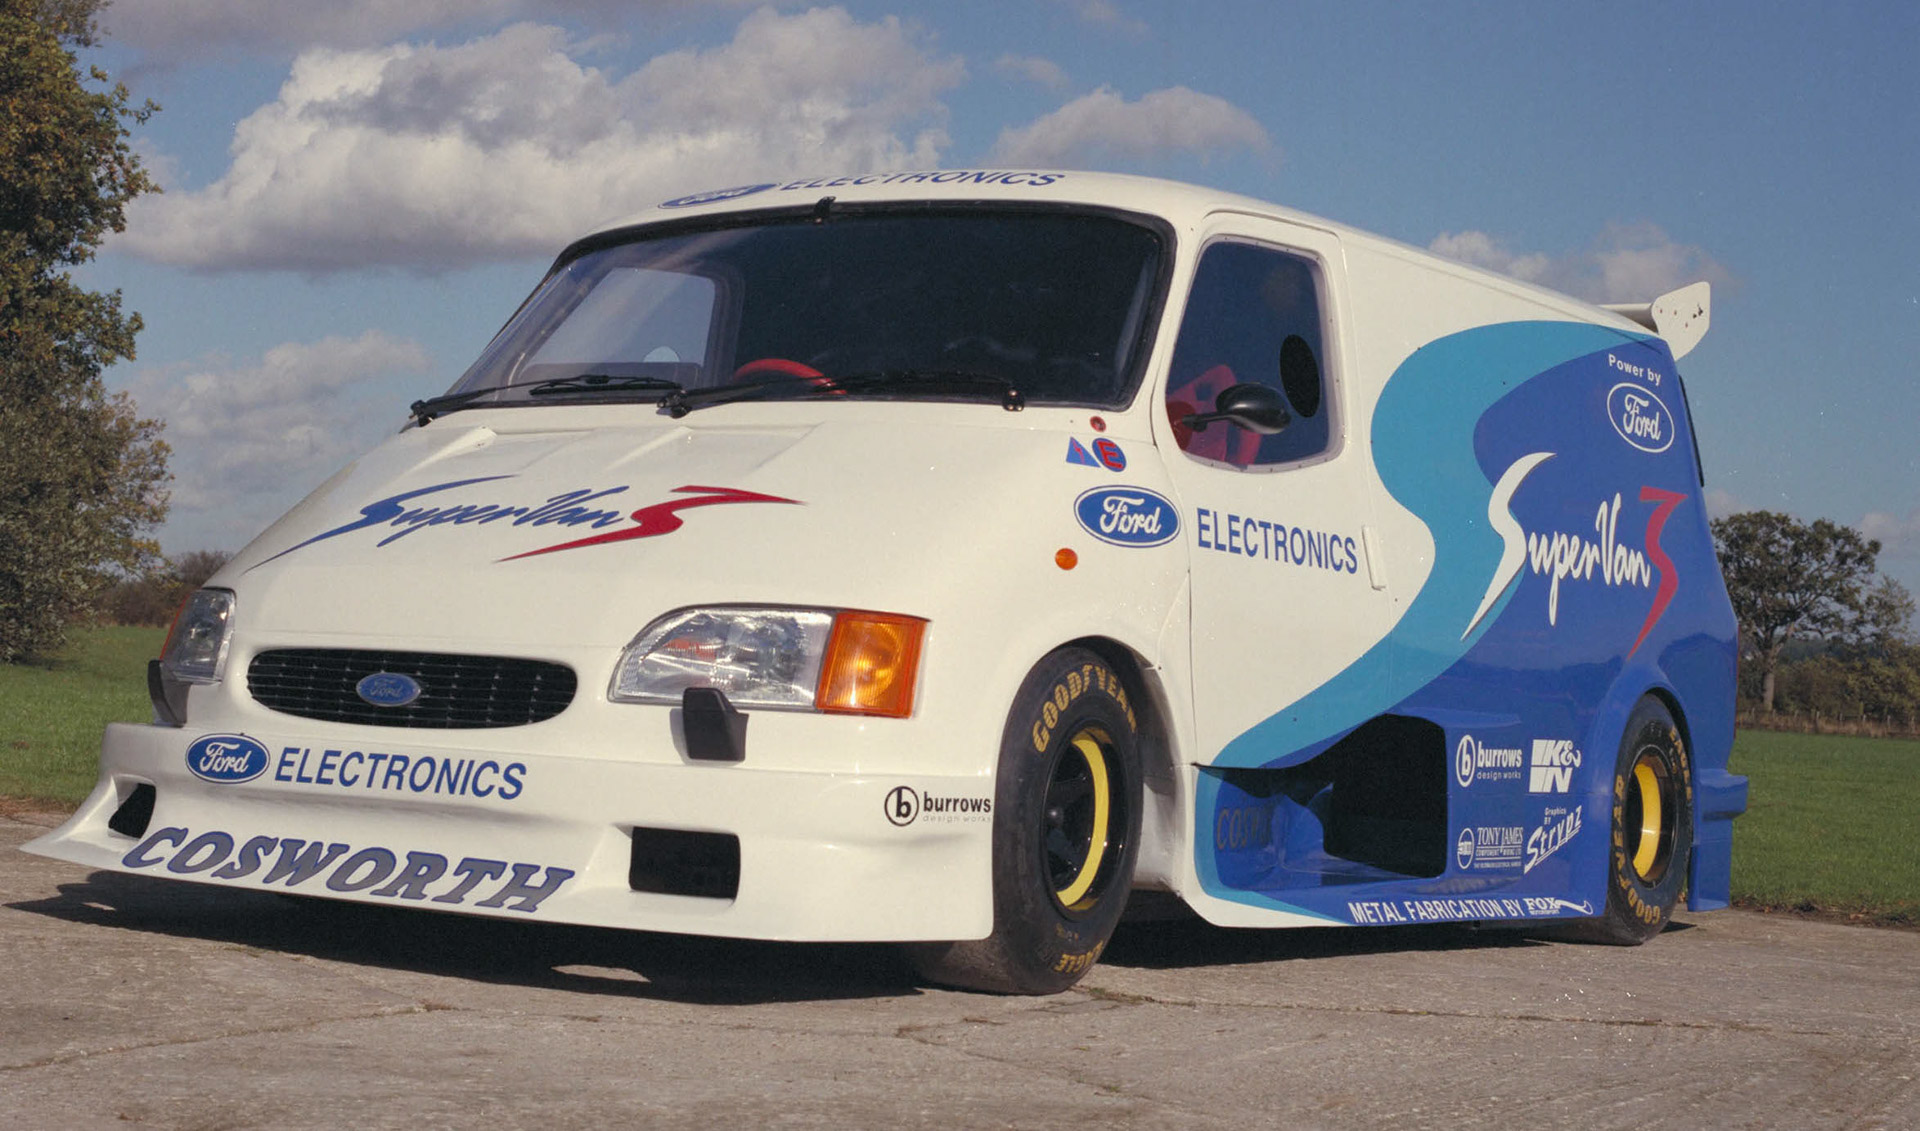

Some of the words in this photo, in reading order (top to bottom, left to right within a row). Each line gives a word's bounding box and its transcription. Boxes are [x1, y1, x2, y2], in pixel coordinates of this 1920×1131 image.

[780, 171, 1065, 191] ELECTRONICS
[1608, 353, 1644, 377] Power
[1647, 367, 1662, 386] by
[1623, 393, 1662, 441] Ford
[1097, 440, 1124, 469] E
[241, 474, 631, 576] SuperVan
[1100, 495, 1162, 535] Ford
[1196, 507, 1358, 575] ELECTRONICS
[1461, 452, 1651, 641] SuperVan
[1627, 485, 1689, 662] 3
[1032, 664, 1137, 752] GOODYEAR
[199, 741, 251, 774] Ford
[1477, 741, 1523, 768] burrows
[274, 747, 527, 800] ELECTRONICS
[1476, 771, 1502, 781] design
[1503, 771, 1522, 779] works
[923, 791, 991, 813] burrows
[923, 815, 960, 823] design
[1477, 826, 1500, 845] TONY
[1500, 826, 1523, 853] JAMES
[1612, 774, 1661, 925] GOODYEAR
[121, 827, 576, 913] COSWORTH
[1348, 901, 1407, 924] METAL
[1403, 899, 1507, 921] FABRICATION
[1502, 899, 1526, 917] BY
[1522, 897, 1561, 909] FOX
